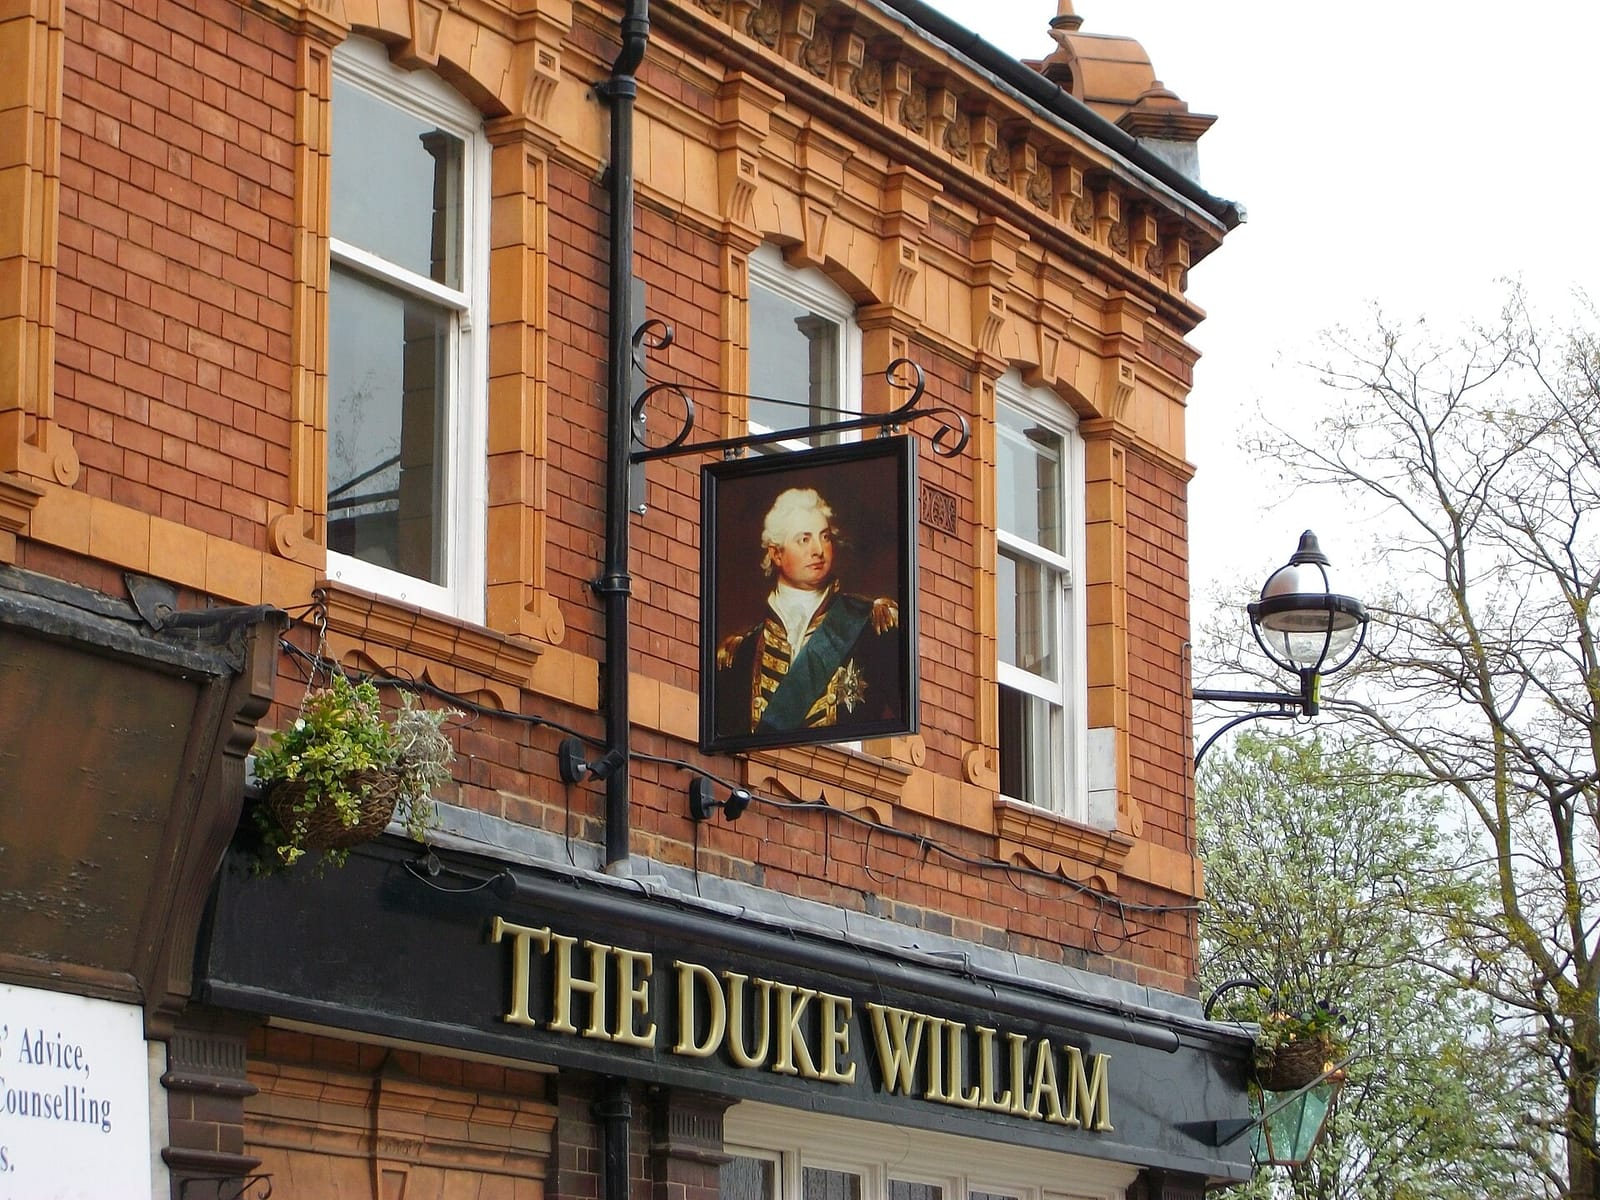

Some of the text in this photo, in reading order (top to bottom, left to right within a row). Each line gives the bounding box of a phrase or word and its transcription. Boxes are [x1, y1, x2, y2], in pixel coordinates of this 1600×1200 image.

[19, 1027, 90, 1079] Advice,
[491, 916, 1114, 1132] THE DUKE WILLIAM
